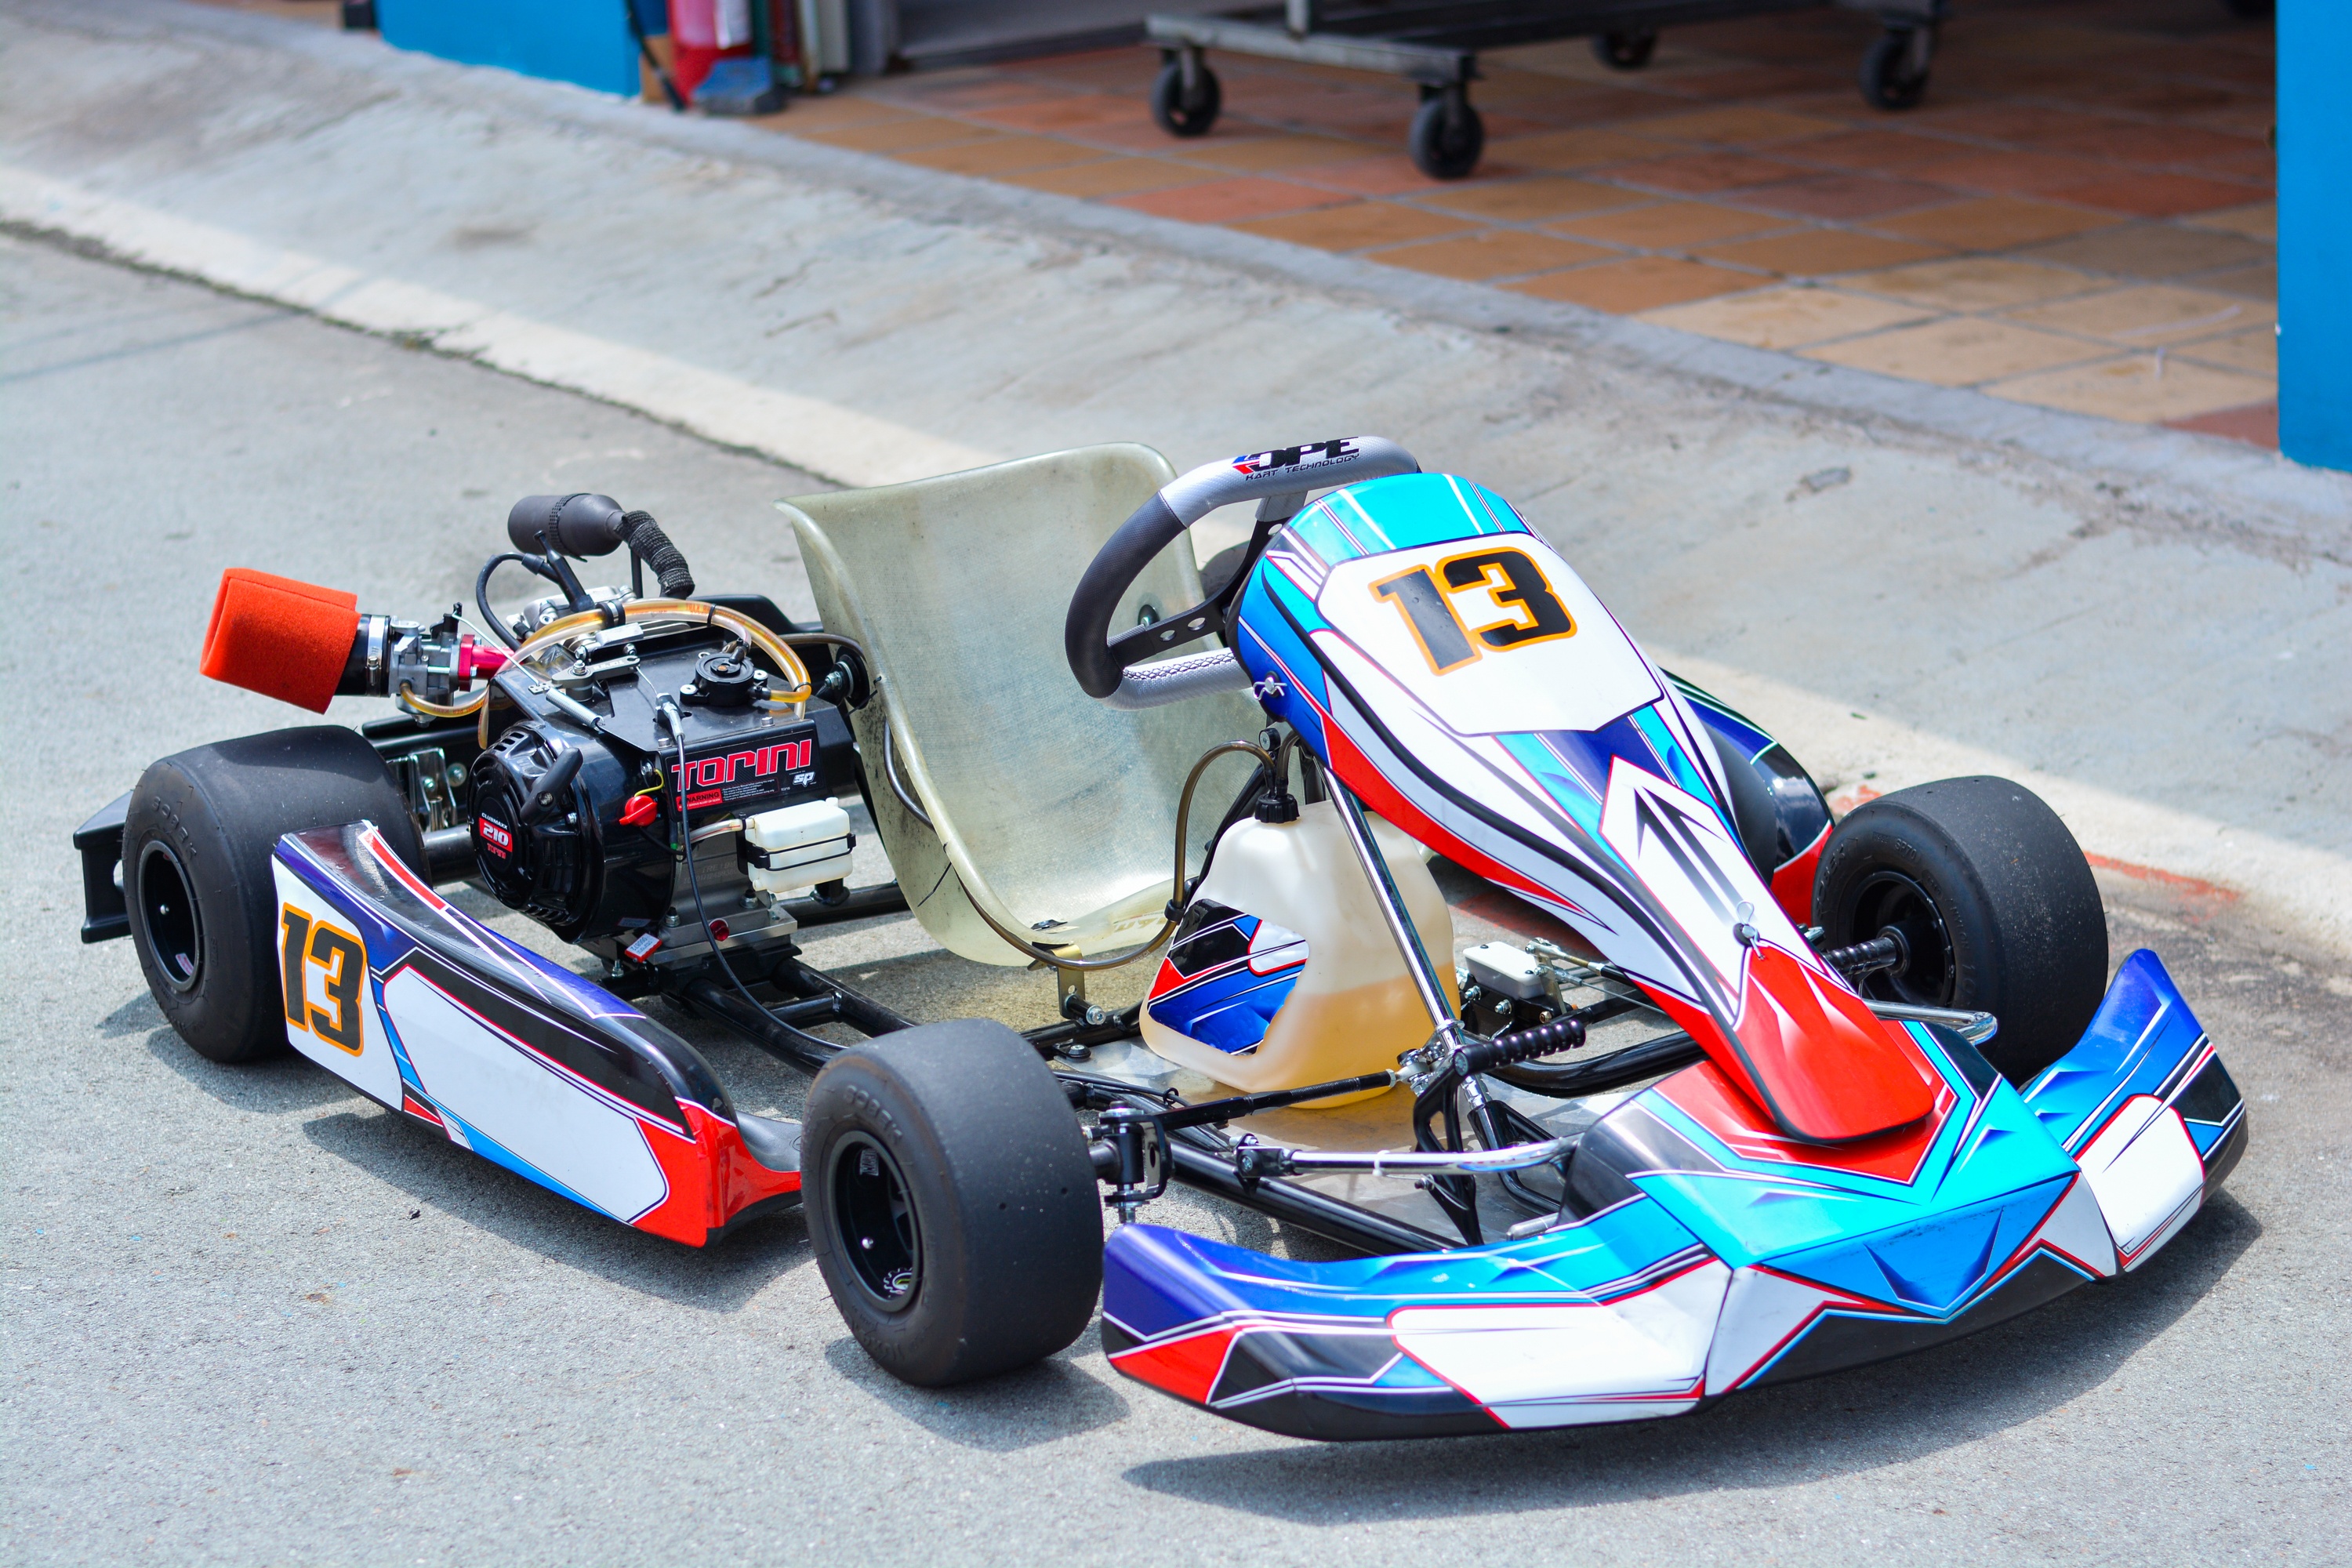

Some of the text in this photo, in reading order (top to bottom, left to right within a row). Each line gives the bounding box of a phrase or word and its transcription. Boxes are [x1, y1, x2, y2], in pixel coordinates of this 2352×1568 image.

[1246, 453, 1360, 481] KART TECHNOLOGY
[1368, 546, 1577, 677] 13
[483, 822, 509, 846] 210
[281, 902, 367, 1057] 13
